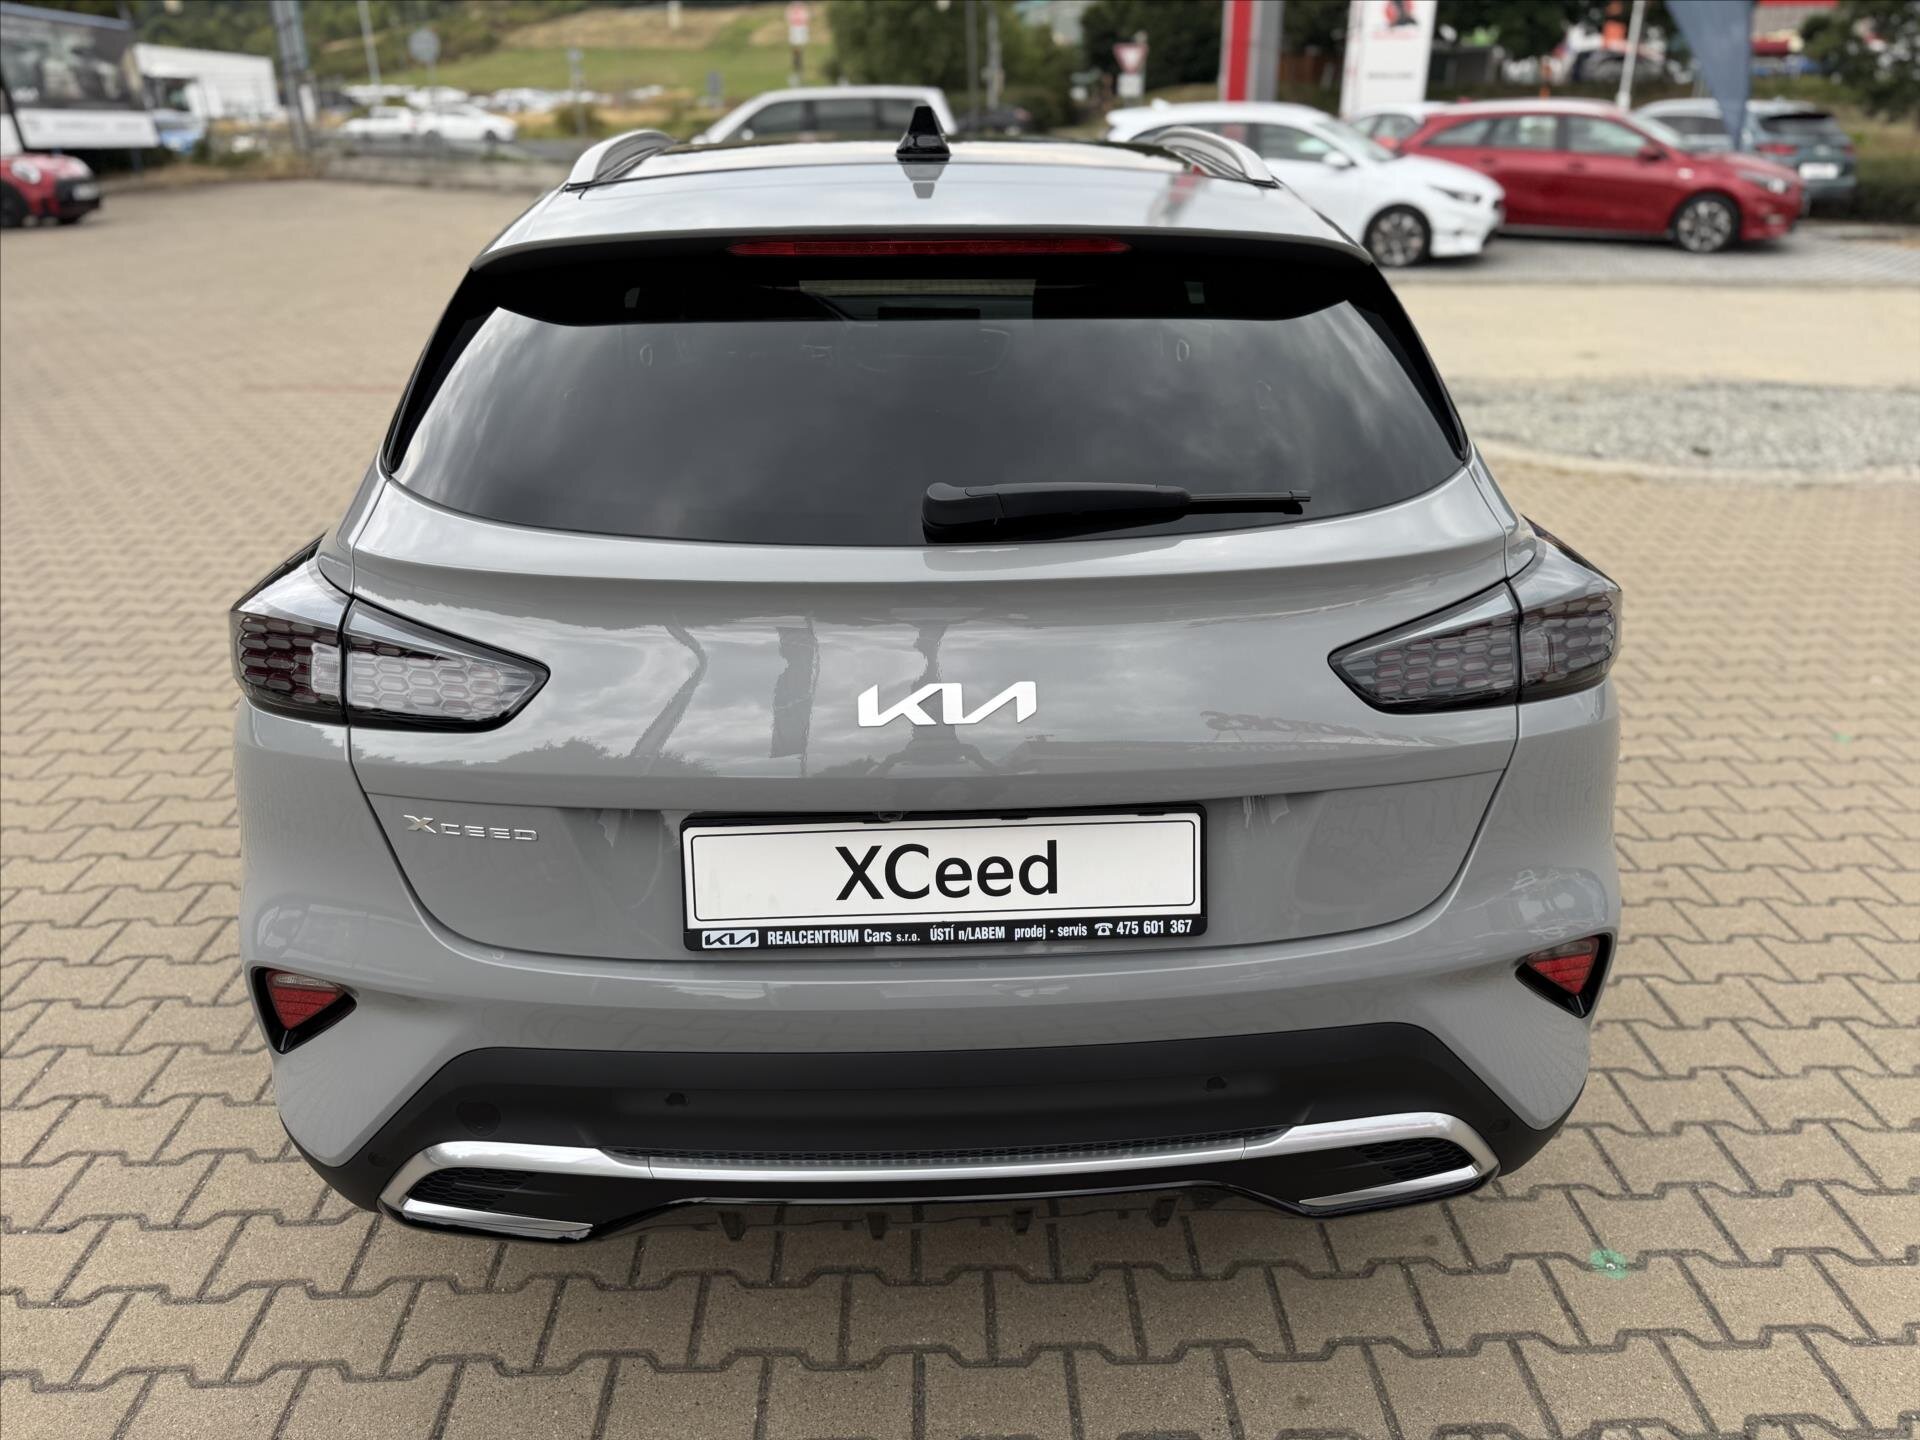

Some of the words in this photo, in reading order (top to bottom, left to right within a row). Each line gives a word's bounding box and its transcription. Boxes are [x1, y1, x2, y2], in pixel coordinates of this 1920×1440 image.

[858, 681, 1037, 726] KIA
[403, 814, 538, 841] XCEED
[834, 839, 1058, 901] XCeed
[704, 932, 757, 946] KIA
[767, 929, 859, 945] REALCENTRUM
[864, 929, 892, 943] Cars
[896, 933, 921, 943] s.r.o.
[930, 924, 955, 941] ÚSTÍ
[958, 926, 1006, 941] n/LABEM
[1014, 923, 1047, 941] prodej
[1057, 922, 1088, 937] servis
[1116, 921, 1139, 935] 475
[1143, 920, 1165, 935] 601
[1170, 919, 1193, 934] 367
